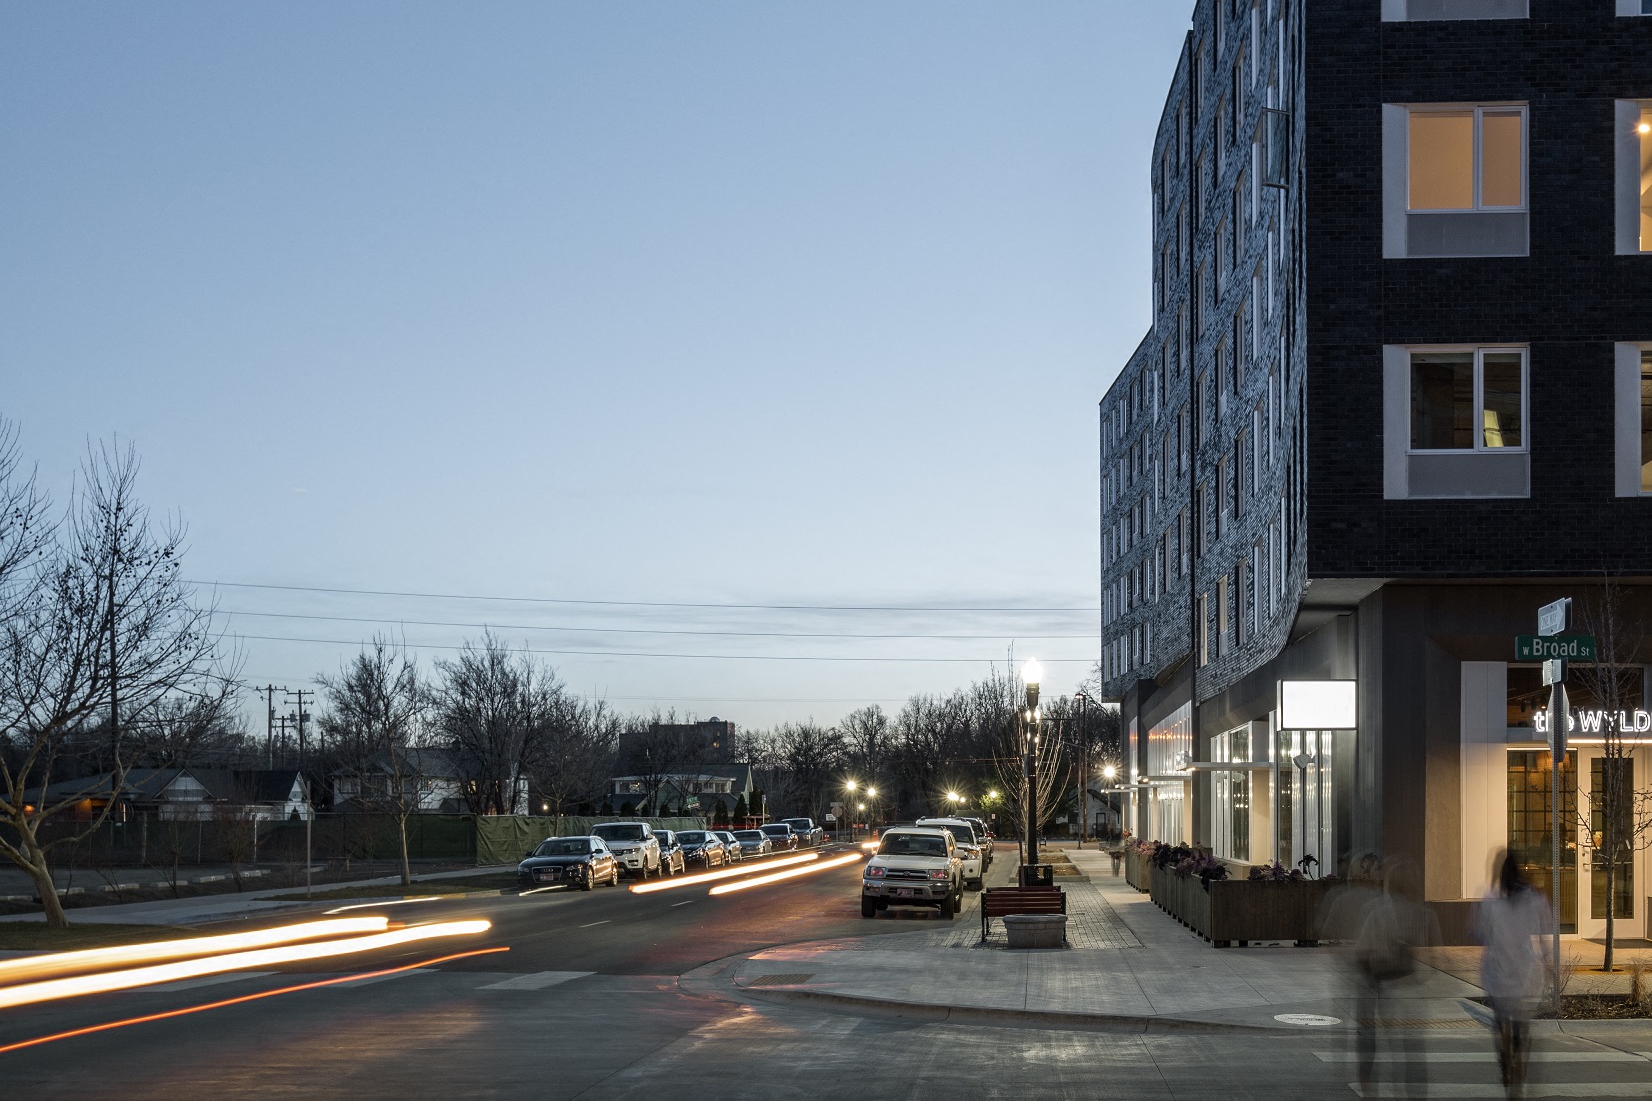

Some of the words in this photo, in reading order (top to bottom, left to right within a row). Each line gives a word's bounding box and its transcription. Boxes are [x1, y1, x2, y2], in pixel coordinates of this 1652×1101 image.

[1523, 646, 1530, 656] W
[1533, 639, 1577, 656] Broad
[1580, 646, 1589, 656] St
